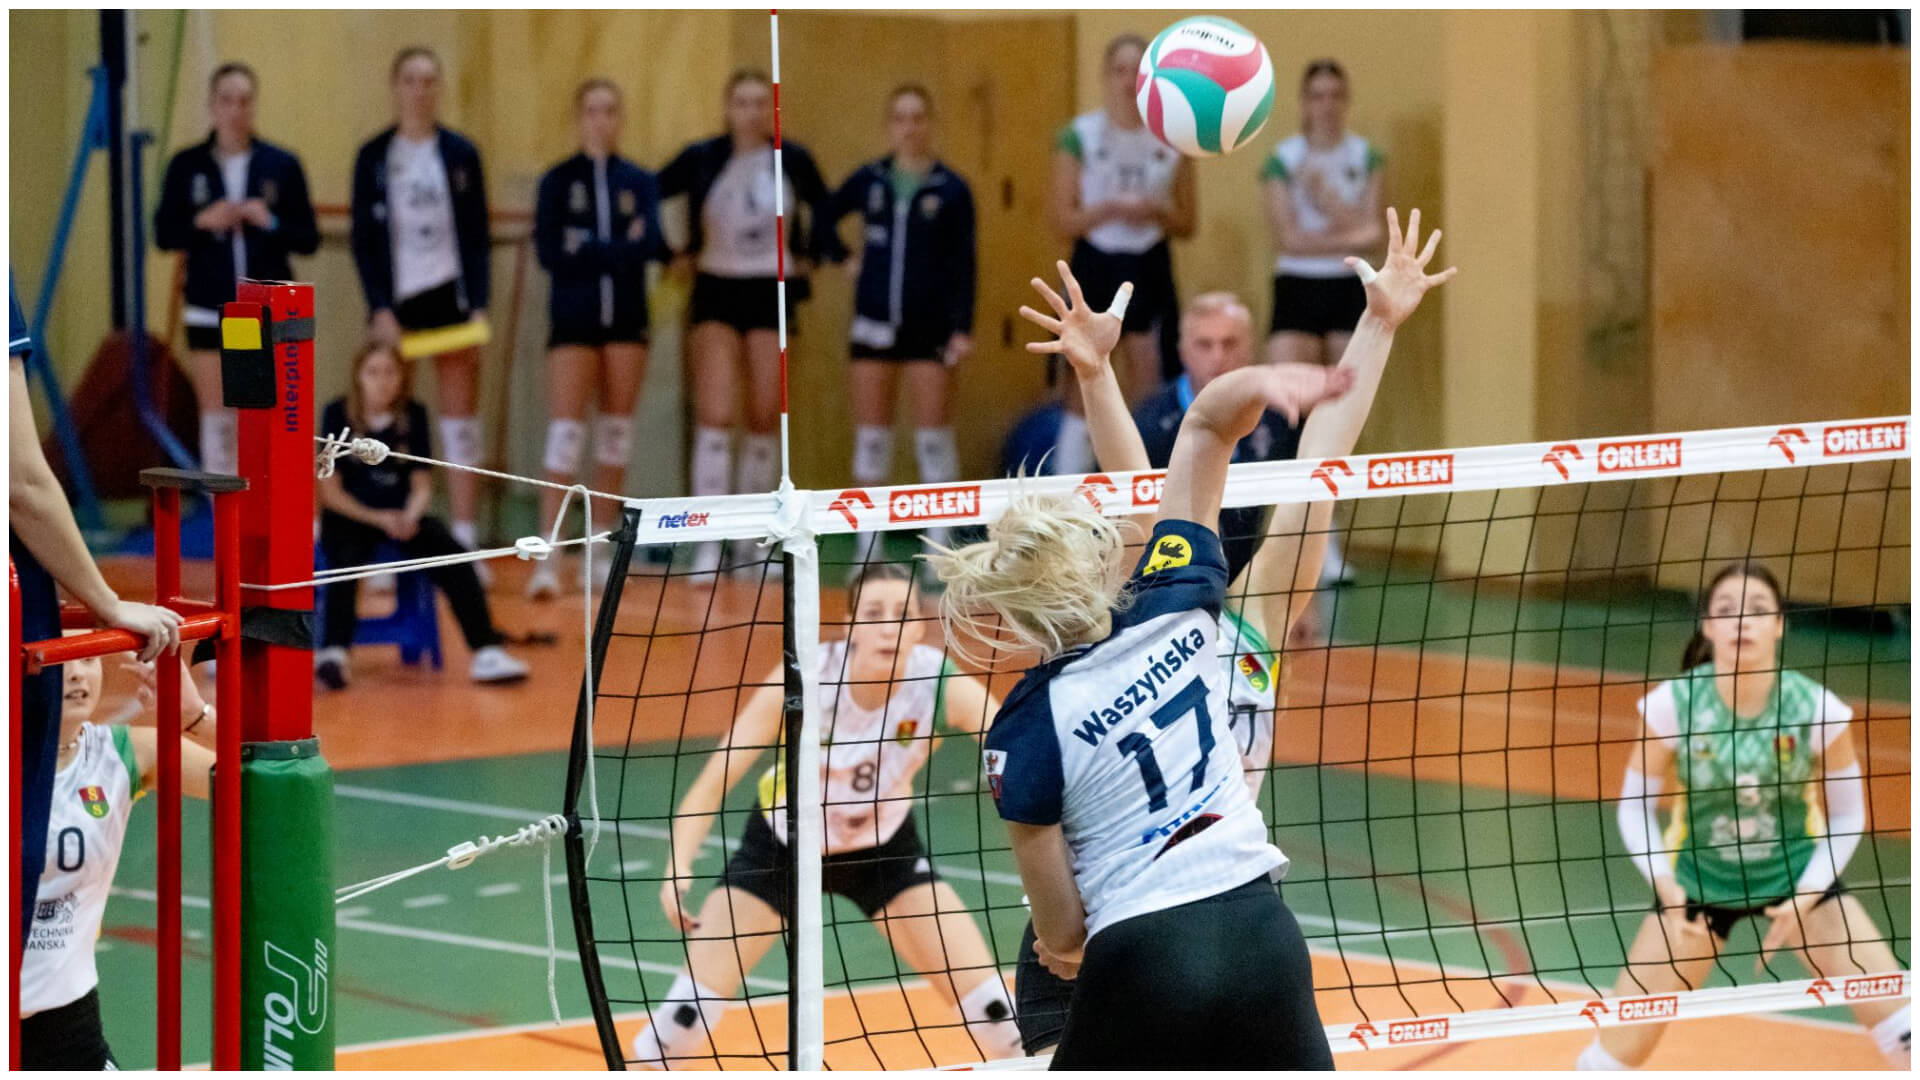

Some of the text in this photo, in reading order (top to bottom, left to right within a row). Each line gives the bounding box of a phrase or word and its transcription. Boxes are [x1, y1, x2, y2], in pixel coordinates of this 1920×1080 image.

[1825, 423, 1905, 452] ORLEN
[1600, 441, 1680, 470] ORLEN
[1369, 458, 1451, 486] ORLEN
[892, 489, 977, 519] ORLEN
[658, 510, 711, 528] netex
[1073, 627, 1206, 747] Waszyńska
[1116, 674, 1216, 814] 17
[851, 761, 876, 793] 8
[1846, 977, 1901, 996] ORLEN
[1620, 999, 1676, 1019] ORLEN
[1389, 1022, 1447, 1041] ORLEN
